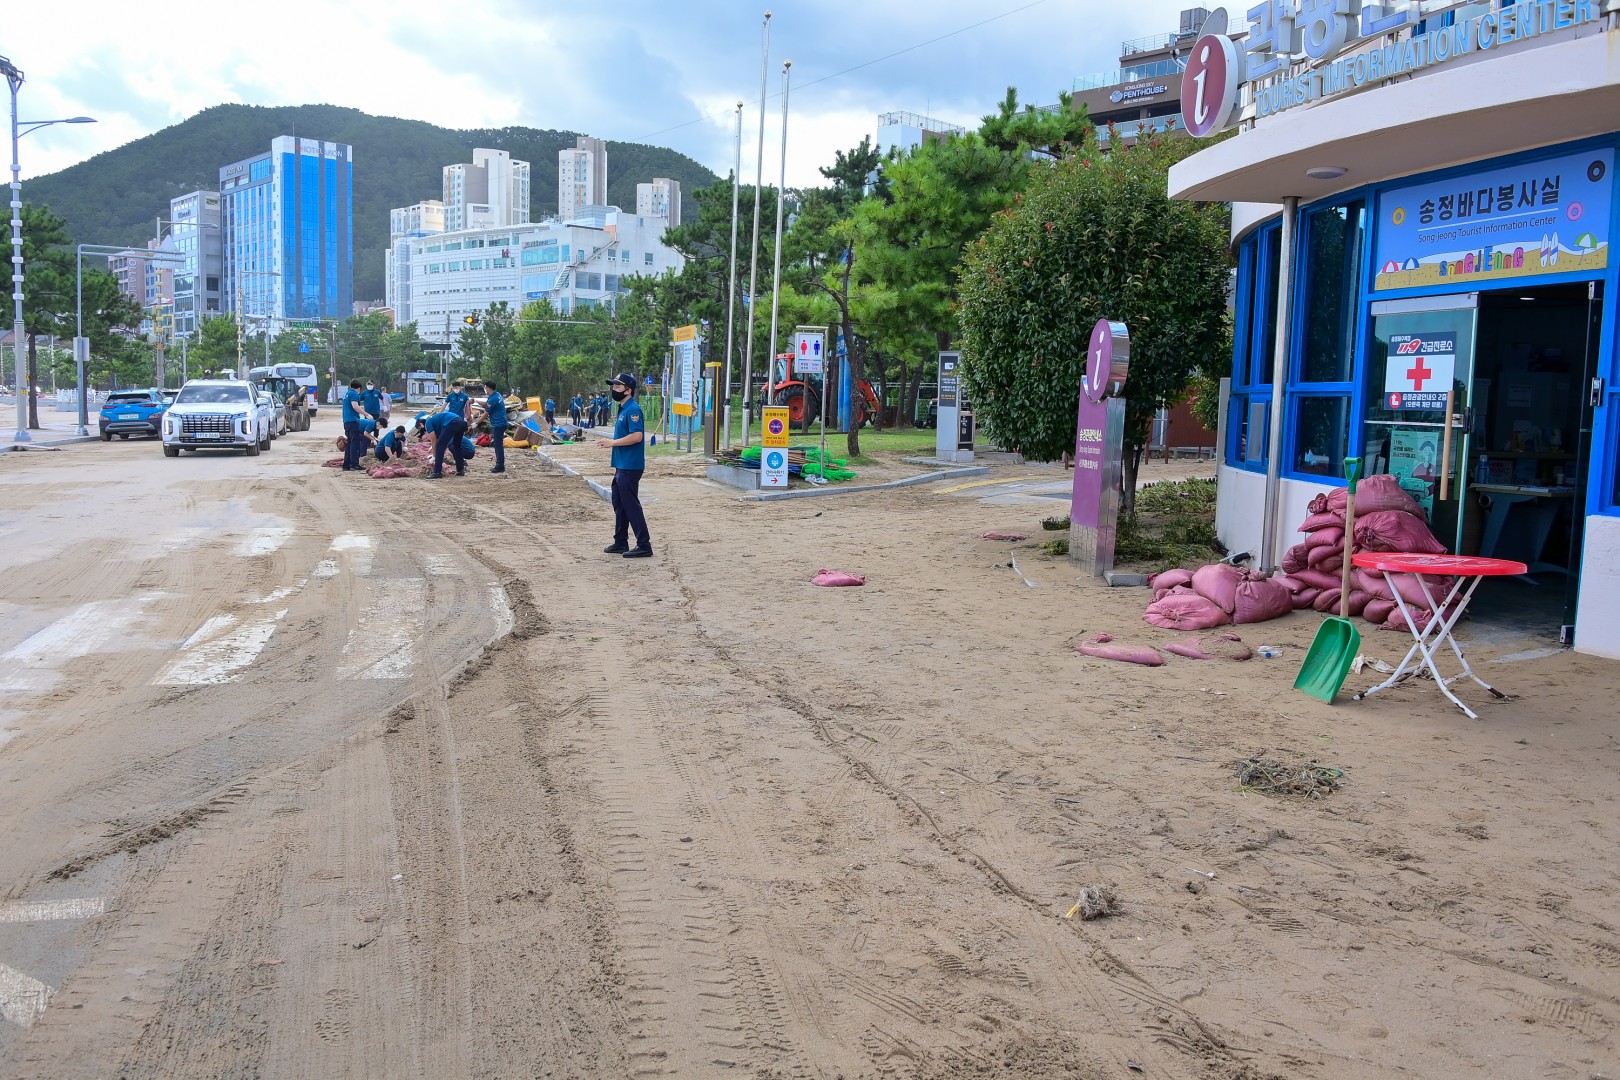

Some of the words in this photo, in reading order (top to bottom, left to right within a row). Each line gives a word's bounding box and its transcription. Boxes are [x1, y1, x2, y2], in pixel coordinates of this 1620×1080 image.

[1254, 71, 1318, 117] TOURIST
[1323, 20, 1469, 96] INFORMATION
[1478, 0, 1592, 50] CENTER
[1419, 175, 1561, 224] 송정바다봉사실
[1418, 230, 1457, 243] Song-jeong
[1458, 226, 1482, 237] Tourist
[1483, 219, 1528, 234] Information
[1529, 215, 1557, 228] Center
[1397, 339, 1421, 354] 119
[1421, 340, 1453, 352] 긴급진료소
